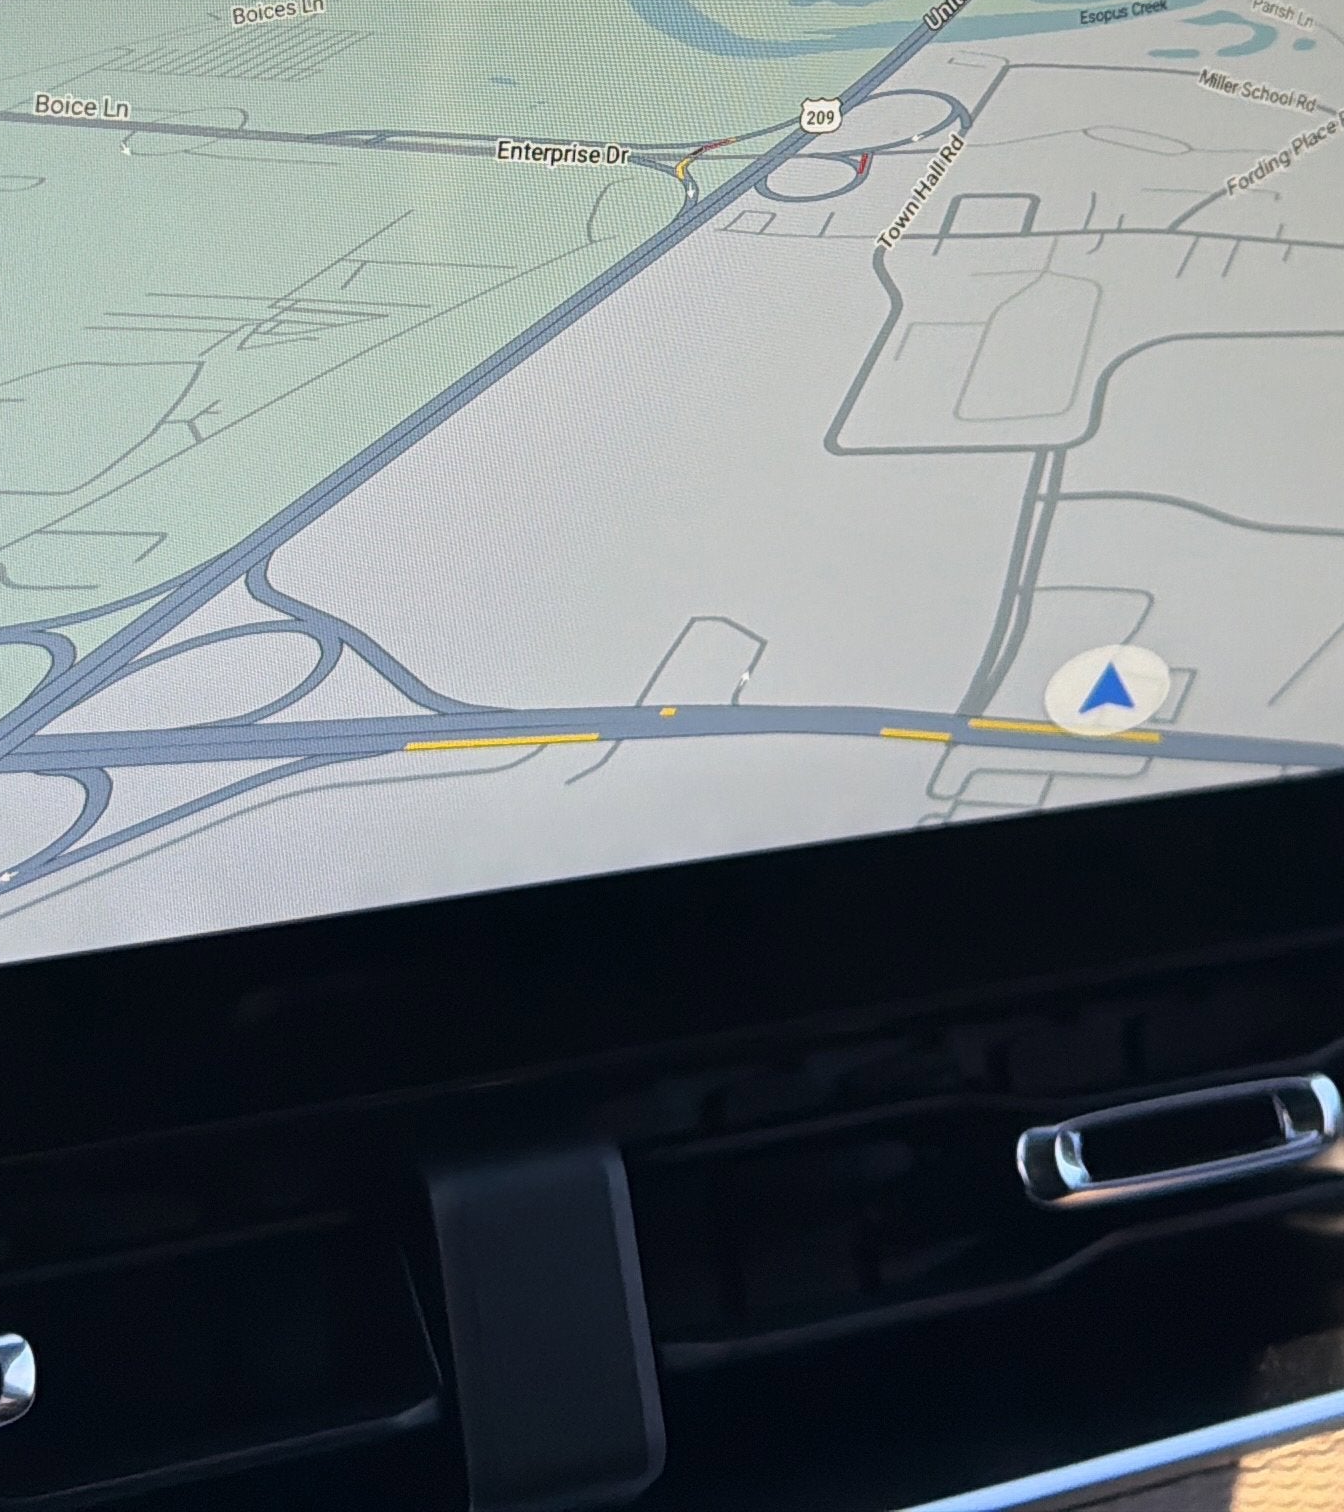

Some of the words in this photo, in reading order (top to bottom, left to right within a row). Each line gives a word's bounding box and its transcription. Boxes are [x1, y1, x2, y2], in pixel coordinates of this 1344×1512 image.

[233, 1, 297, 25] Boices
[1079, 7, 1123, 25] Esopus
[1296, 10, 1314, 29] Ln
[1198, 68, 1238, 97] Miller
[1241, 79, 1291, 108] School
[1295, 94, 1317, 114] Rd
[35, 93, 94, 118] Boice
[101, 96, 130, 119] Ln
[805, 108, 834, 128] 209
[496, 140, 598, 168] Enterprise
[603, 143, 630, 167] Dr
[1226, 151, 1291, 195] Fording
[1291, 122, 1338, 157] Place
[876, 198, 923, 248] Town
[912, 163, 945, 204] Hall
[935, 134, 964, 166] Rd
